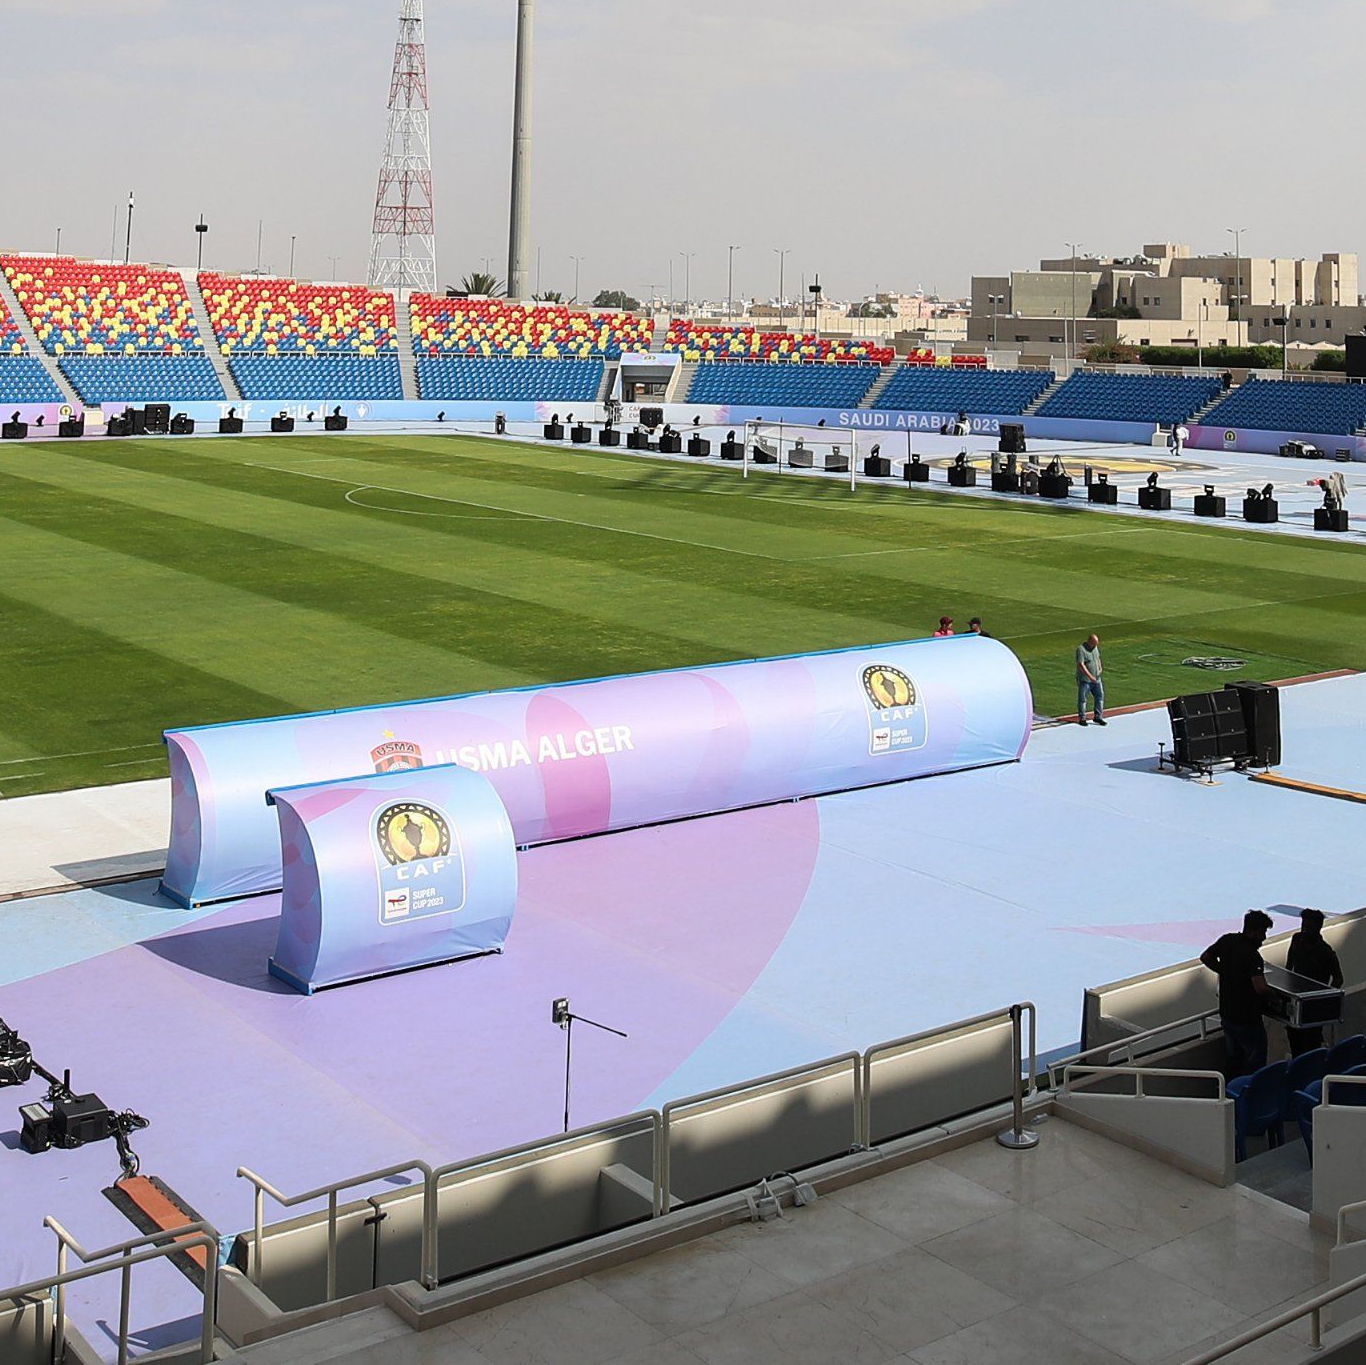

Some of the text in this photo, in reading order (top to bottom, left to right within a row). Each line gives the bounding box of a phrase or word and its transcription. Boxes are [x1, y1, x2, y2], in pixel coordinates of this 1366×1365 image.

[839, 412, 1000, 432] SAUDI ARABIA 023
[881, 707, 914, 722] CAF
[376, 742, 415, 756] USMA
[537, 724, 635, 764] ALGER
[396, 859, 445, 880] CAF
[412, 887, 436, 900] SUPER
[412, 896, 444, 910] CUP 2023
